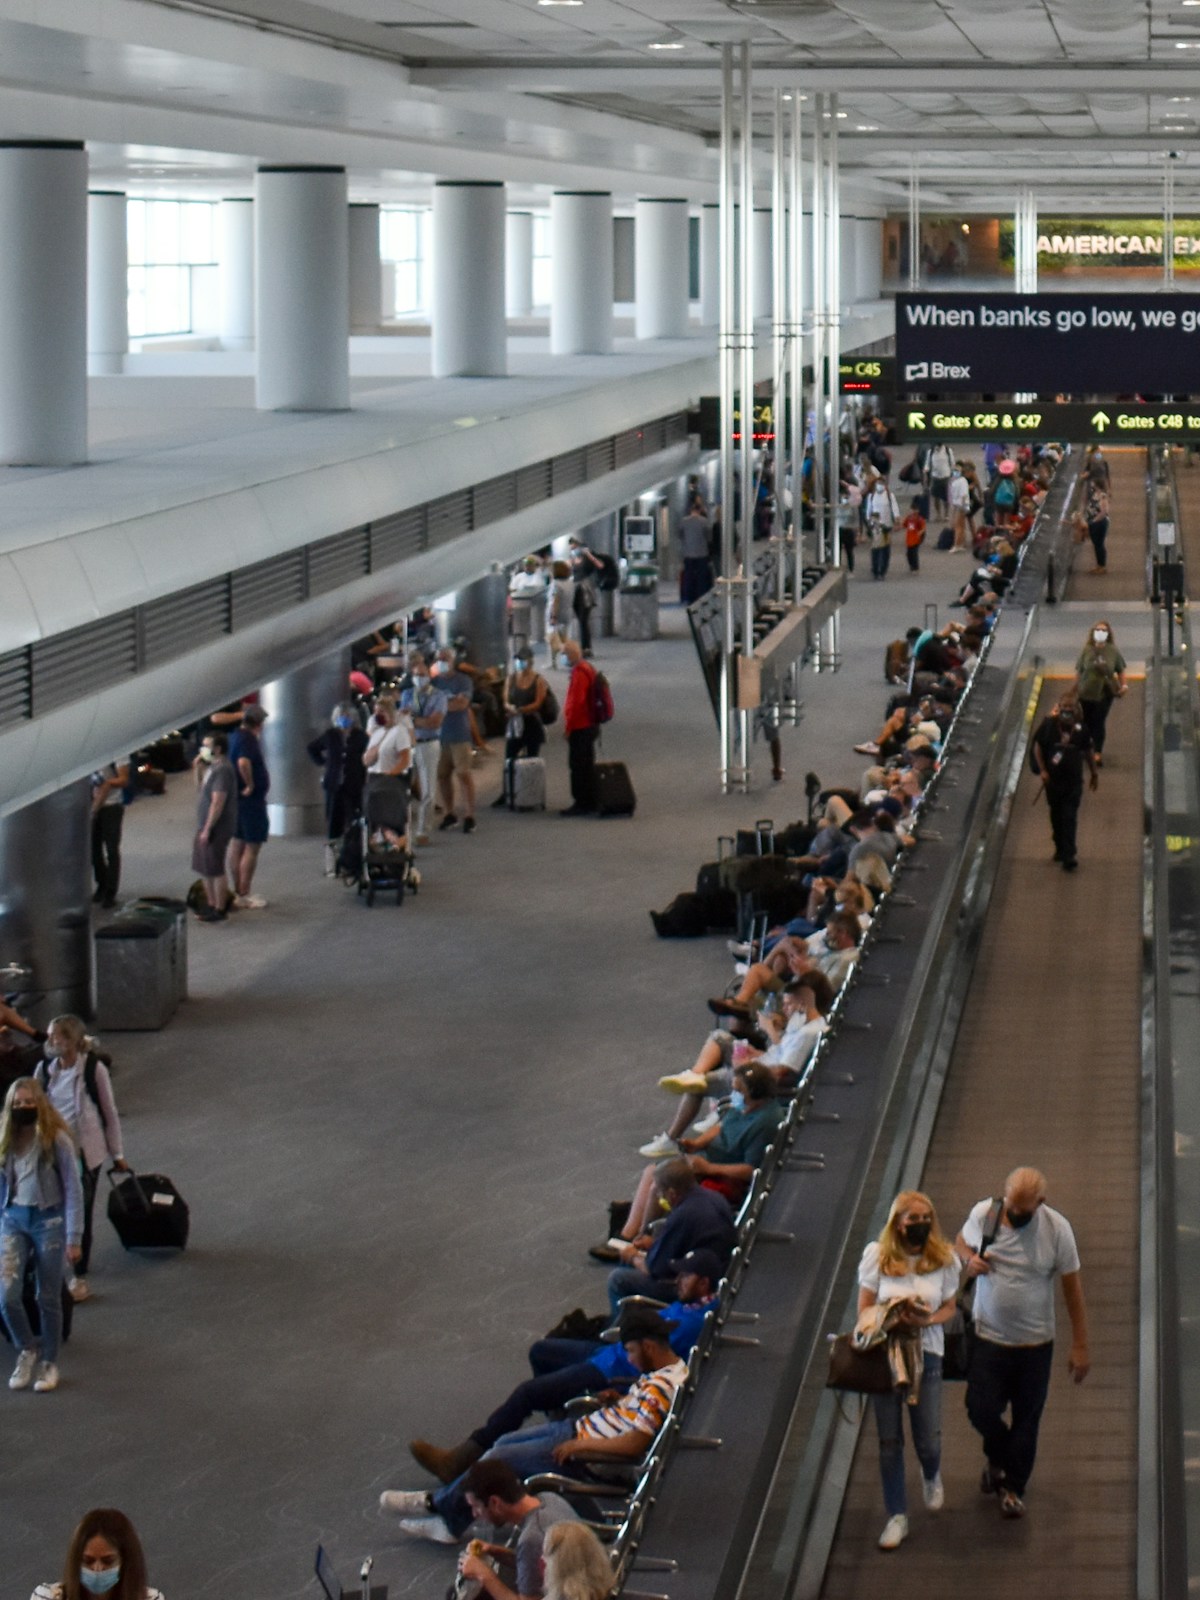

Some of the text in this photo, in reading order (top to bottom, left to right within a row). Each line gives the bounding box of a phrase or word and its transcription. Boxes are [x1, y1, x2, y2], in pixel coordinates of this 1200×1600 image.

[1037, 235, 1162, 253] AMERICAN
[906, 305, 975, 326] When
[980, 306, 1051, 326] banks
[1056, 311, 1087, 332] go
[1092, 306, 1136, 331] low,
[1142, 311, 1176, 326] we
[855, 362, 881, 376] C45
[931, 363, 971, 379] Brex
[932, 414, 1042, 428] Gates C45 & C47
[1117, 414, 1155, 428] Gates
[1158, 414, 1183, 428] C48
